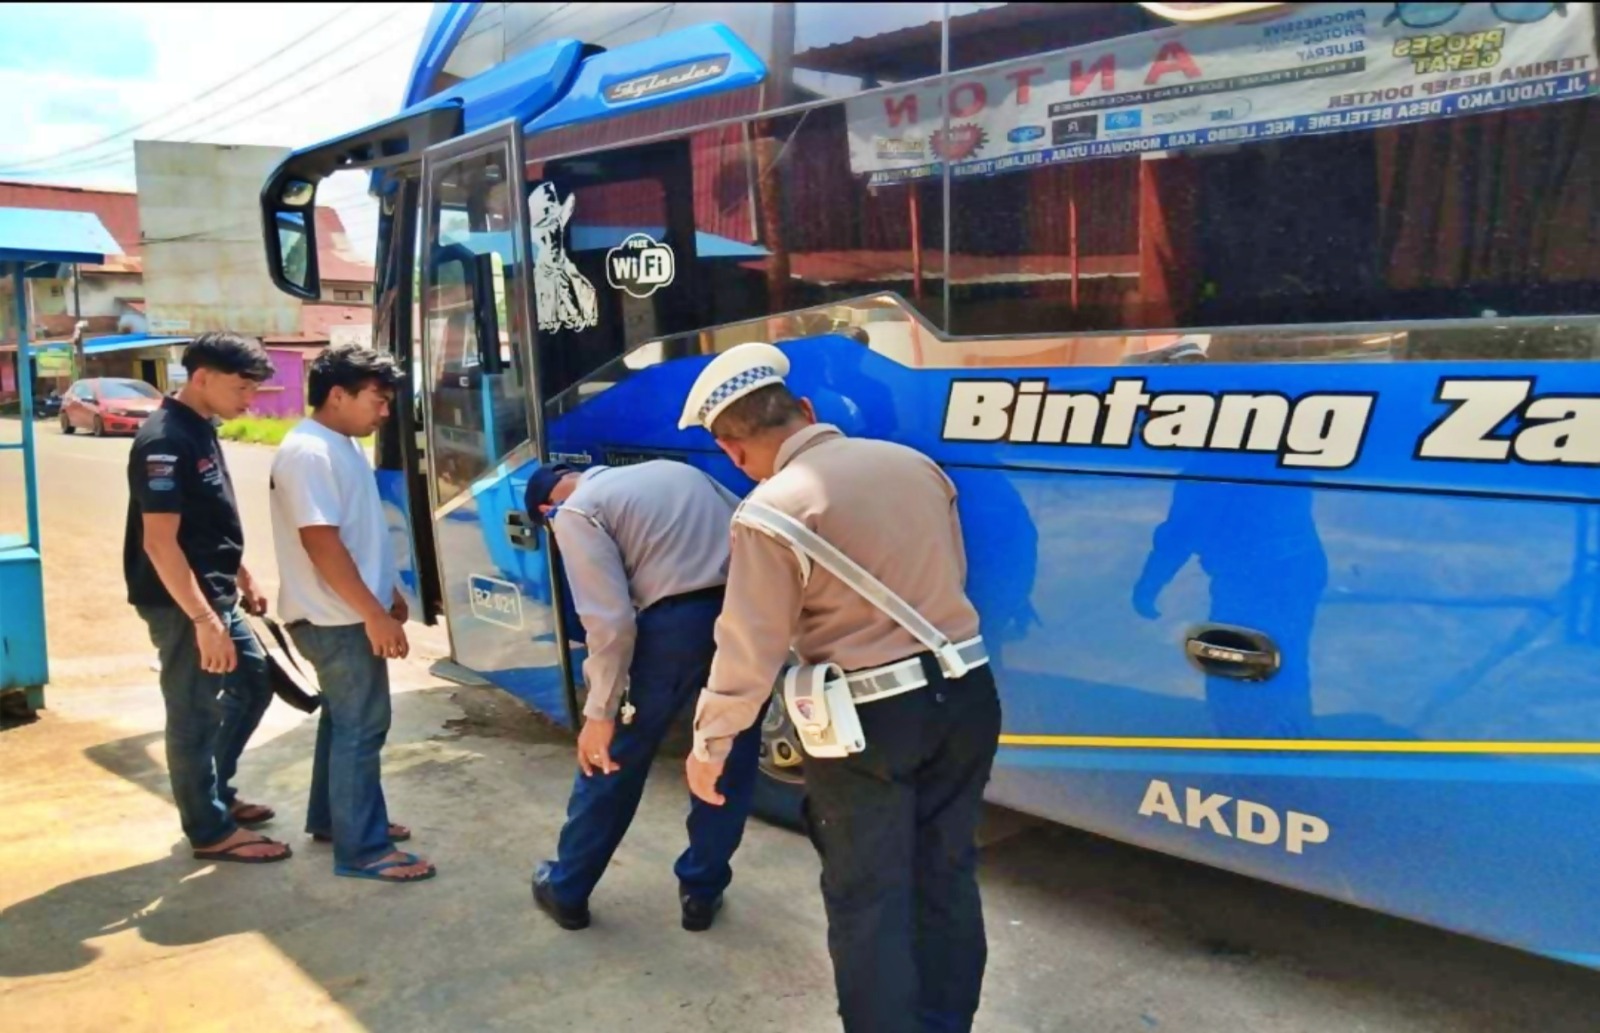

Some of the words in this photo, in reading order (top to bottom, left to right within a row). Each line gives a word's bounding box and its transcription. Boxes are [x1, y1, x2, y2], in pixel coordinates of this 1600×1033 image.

[612, 254, 662, 280] WiFi
[628, 239, 649, 250] FREE
[940, 377, 1380, 470] Bintang
[1137, 779, 1330, 855] AKDP
